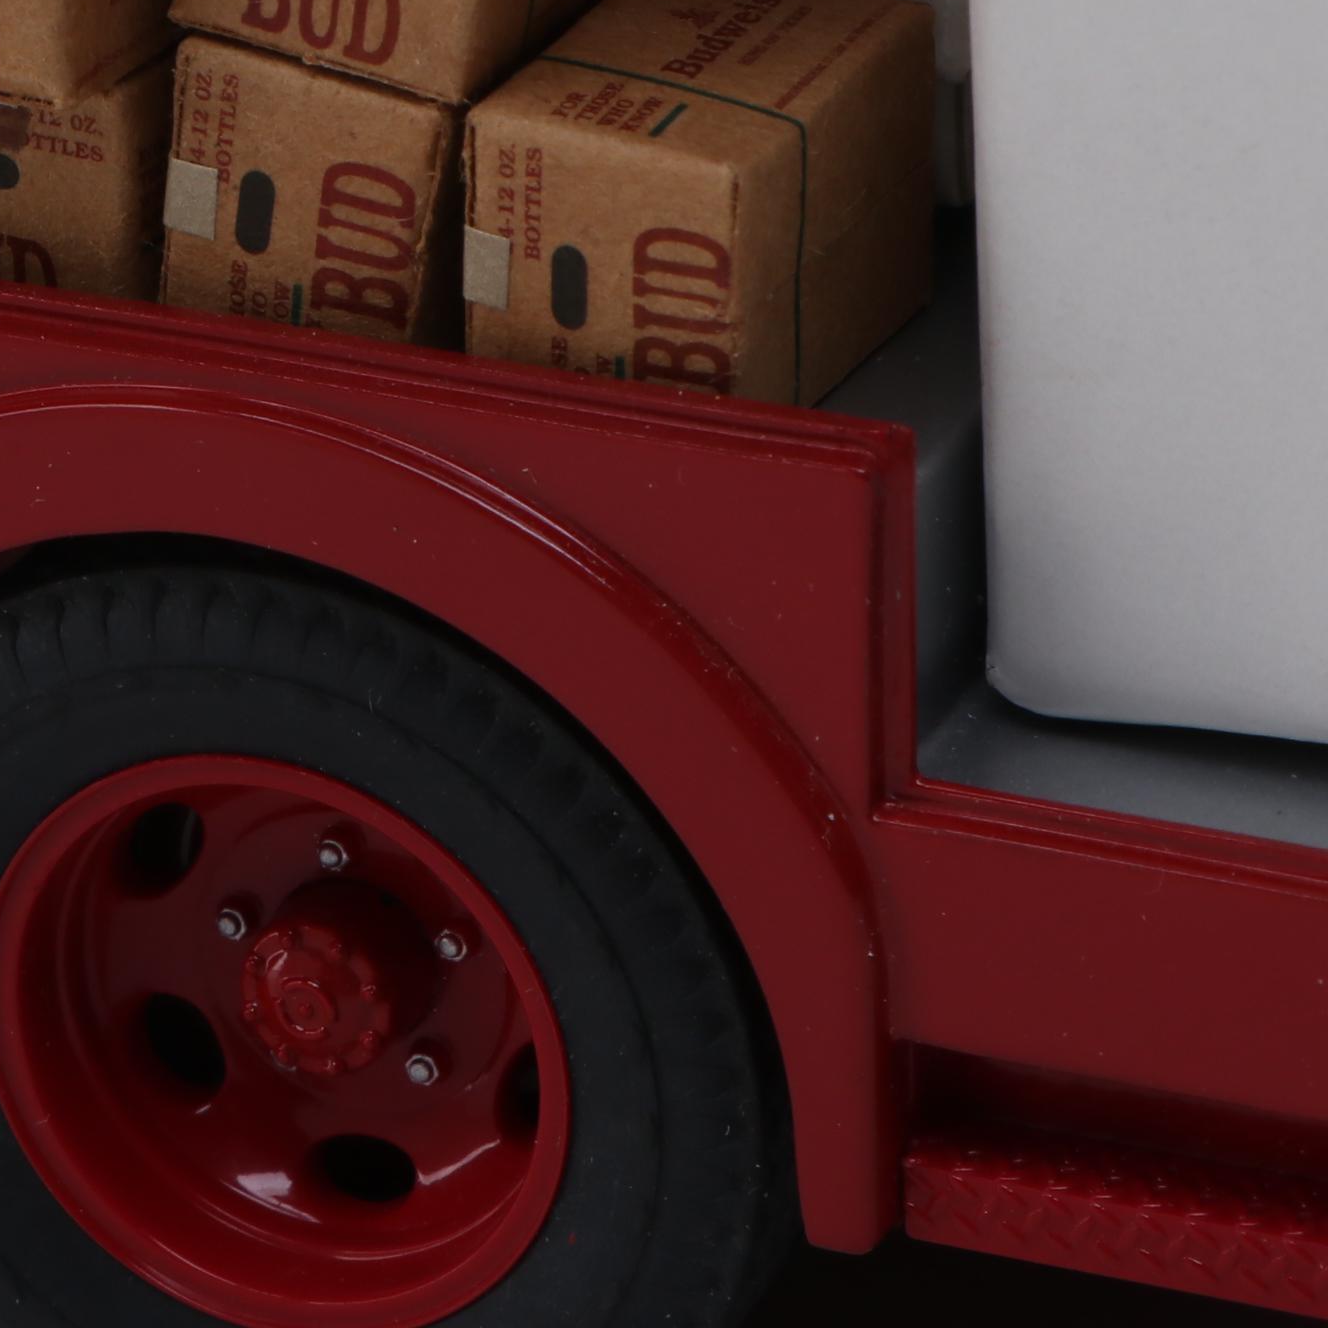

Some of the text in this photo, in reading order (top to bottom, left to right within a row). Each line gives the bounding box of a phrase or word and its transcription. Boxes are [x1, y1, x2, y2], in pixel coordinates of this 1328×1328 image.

[215, 73, 240, 185] BOTTLES
[552, 90, 584, 118] FOR
[575, 80, 626, 121] THOSE
[596, 97, 636, 127] WHO
[618, 95, 664, 132] KNOW
[190, 108, 209, 165] 4-12
[524, 147, 543, 261] BOTTLES
[309, 161, 416, 332] BUD
[632, 226, 732, 394] BUD
